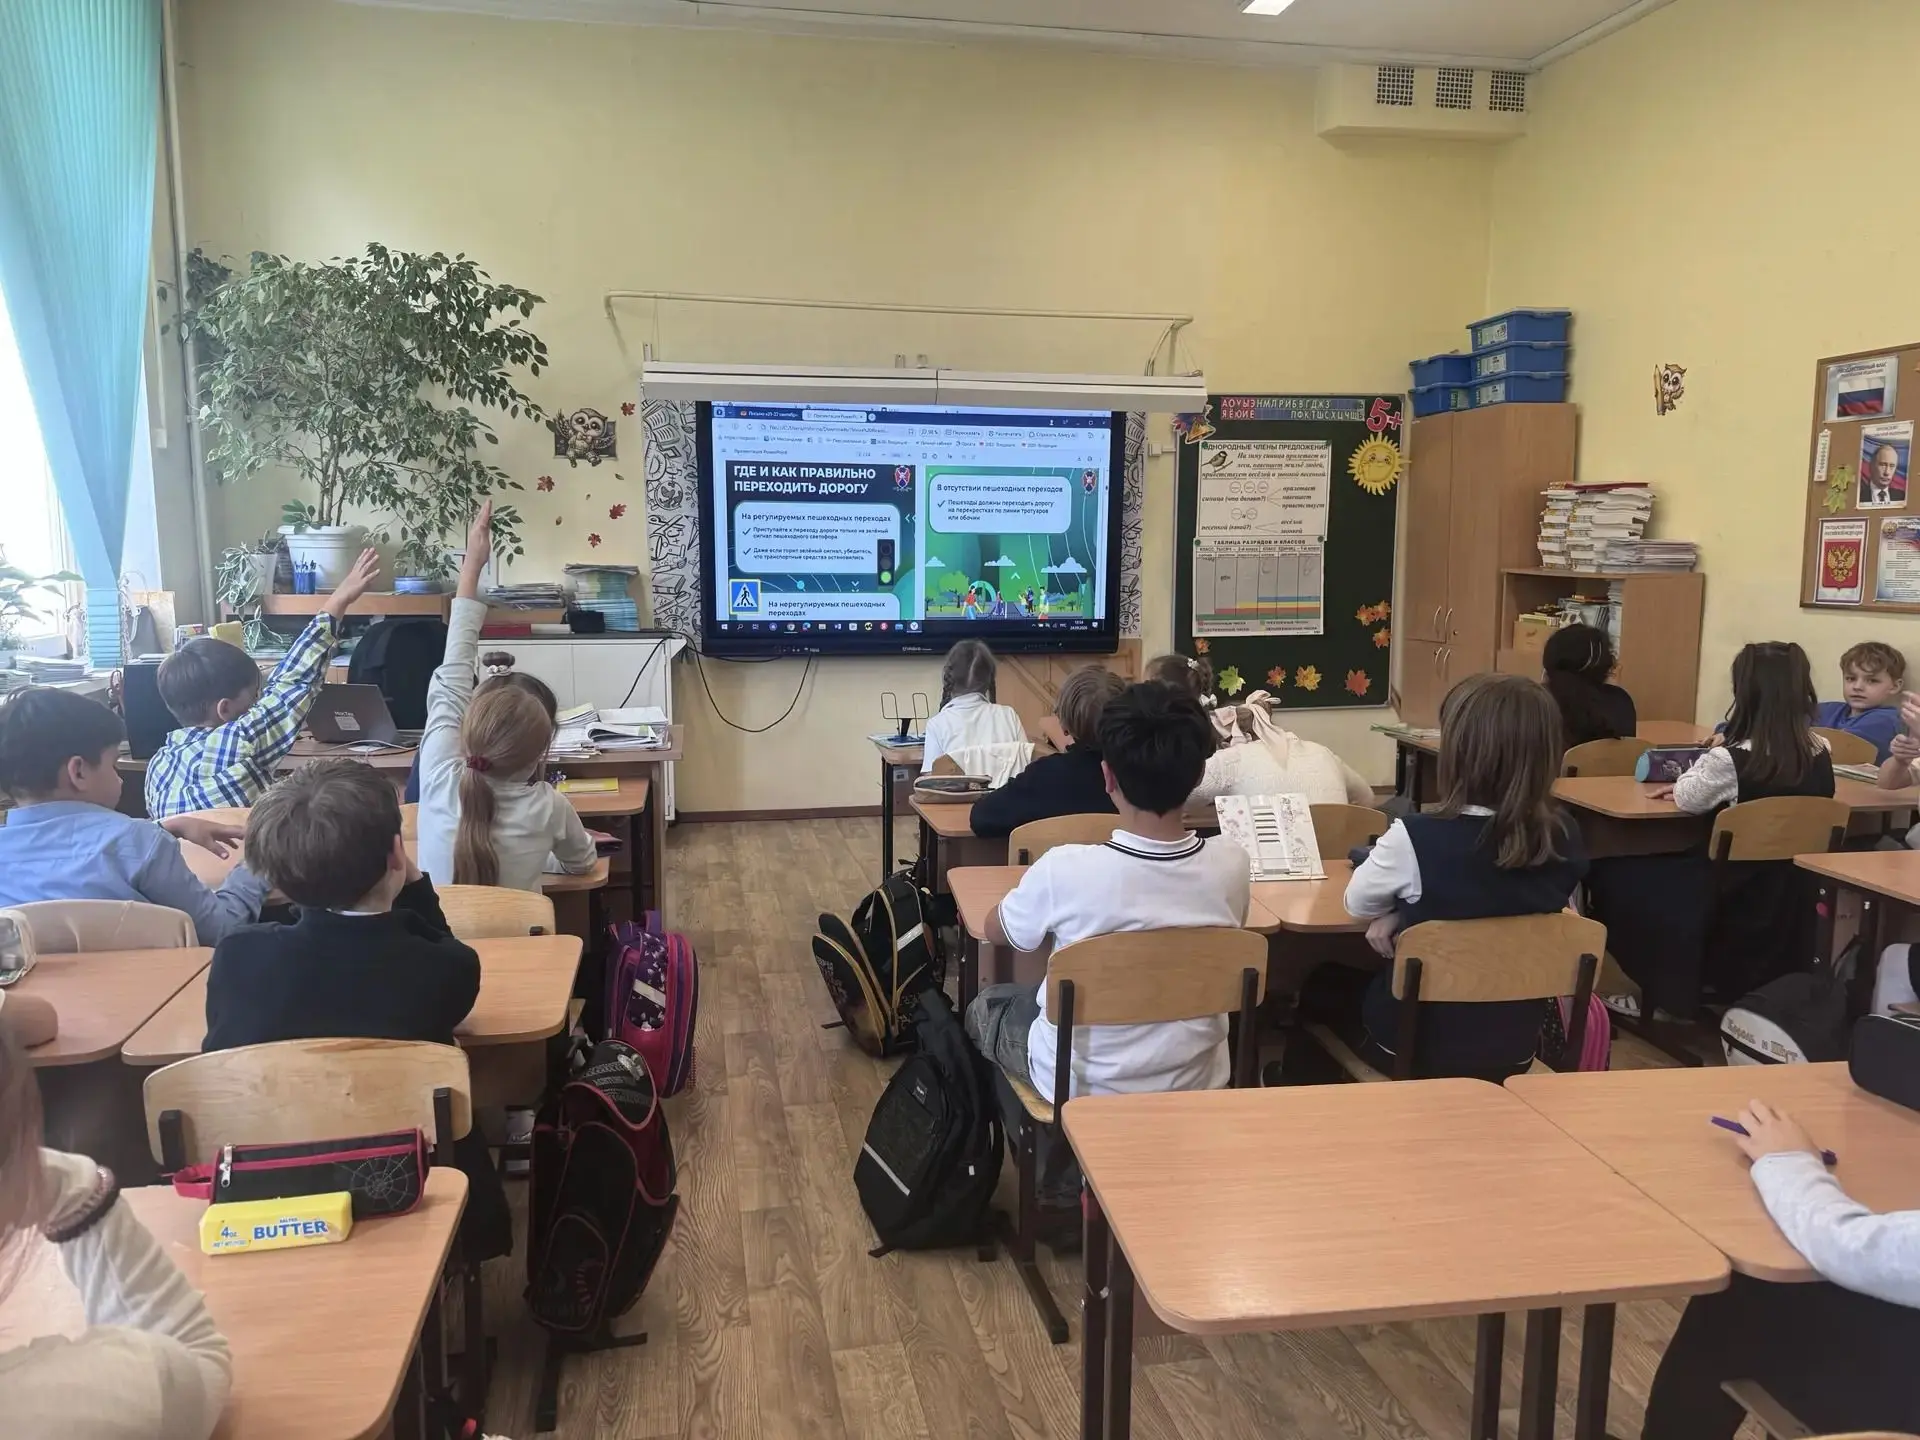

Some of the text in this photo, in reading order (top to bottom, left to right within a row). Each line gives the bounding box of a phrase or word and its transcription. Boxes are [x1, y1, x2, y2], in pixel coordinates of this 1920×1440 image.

[1367, 398, 1403, 432] 5+
[734, 465, 876, 479] ГДЕ И КАК ПРАВИЛЬНО
[734, 481, 869, 494] ПЕРЕХОДИТЬ ДОРОГУ
[753, 514, 805, 522] регулируемых
[254, 1220, 328, 1240] BUTTER
